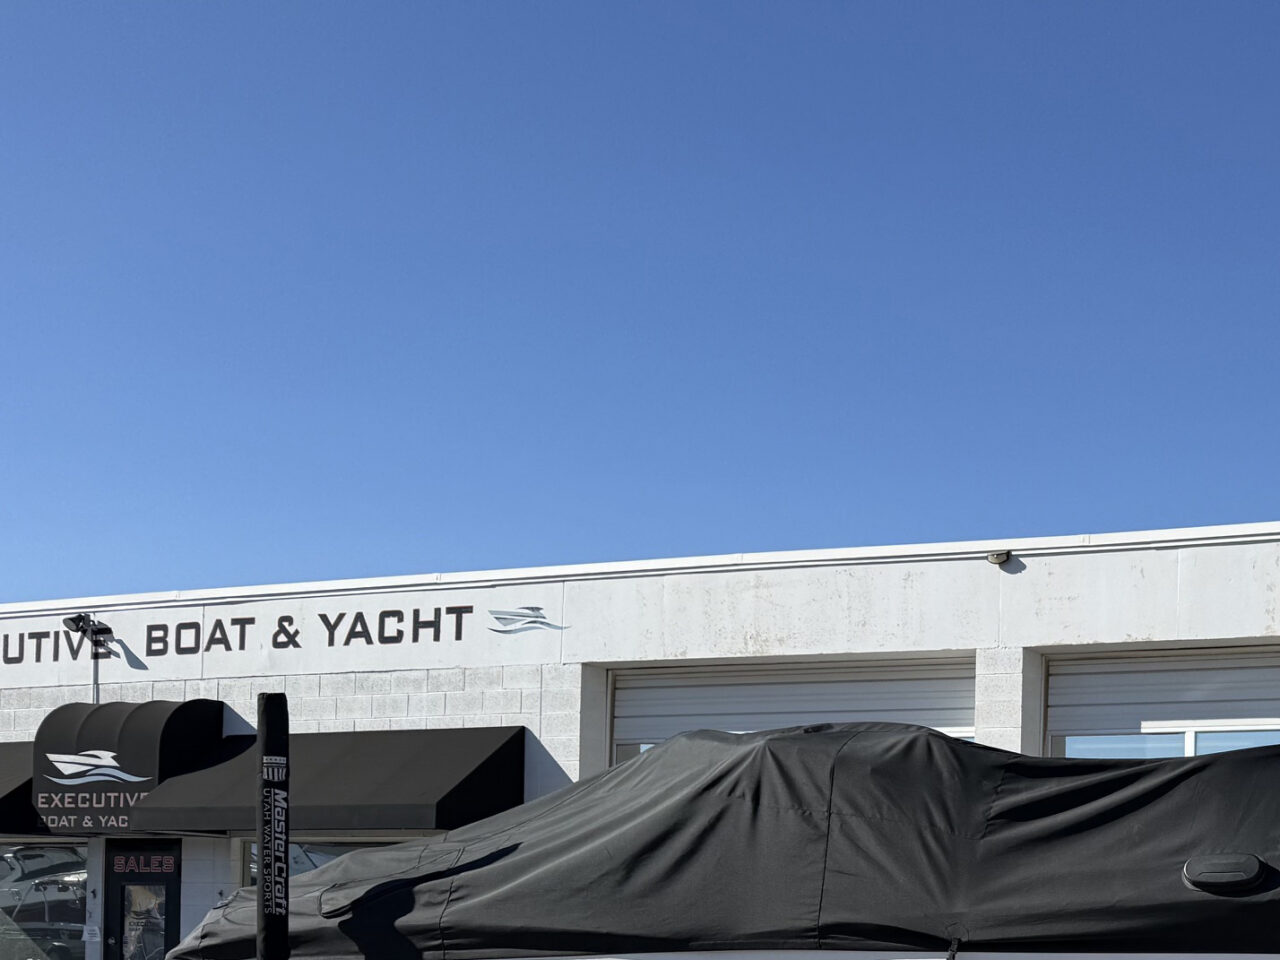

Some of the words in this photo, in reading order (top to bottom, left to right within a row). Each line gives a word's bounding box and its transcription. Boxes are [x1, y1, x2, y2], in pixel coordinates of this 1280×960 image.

[145, 616, 256, 657] BOAT
[271, 614, 301, 649] &
[317, 605, 474, 648] YACHT
[37, 792, 150, 808] EXECUTIV
[263, 788, 271, 820] UTAH
[82, 815, 93, 828] &
[263, 825, 271, 864] WATER
[274, 788, 288, 916] MasterCraft
[113, 855, 175, 873] SALES
[263, 868, 272, 914] SPORTS
